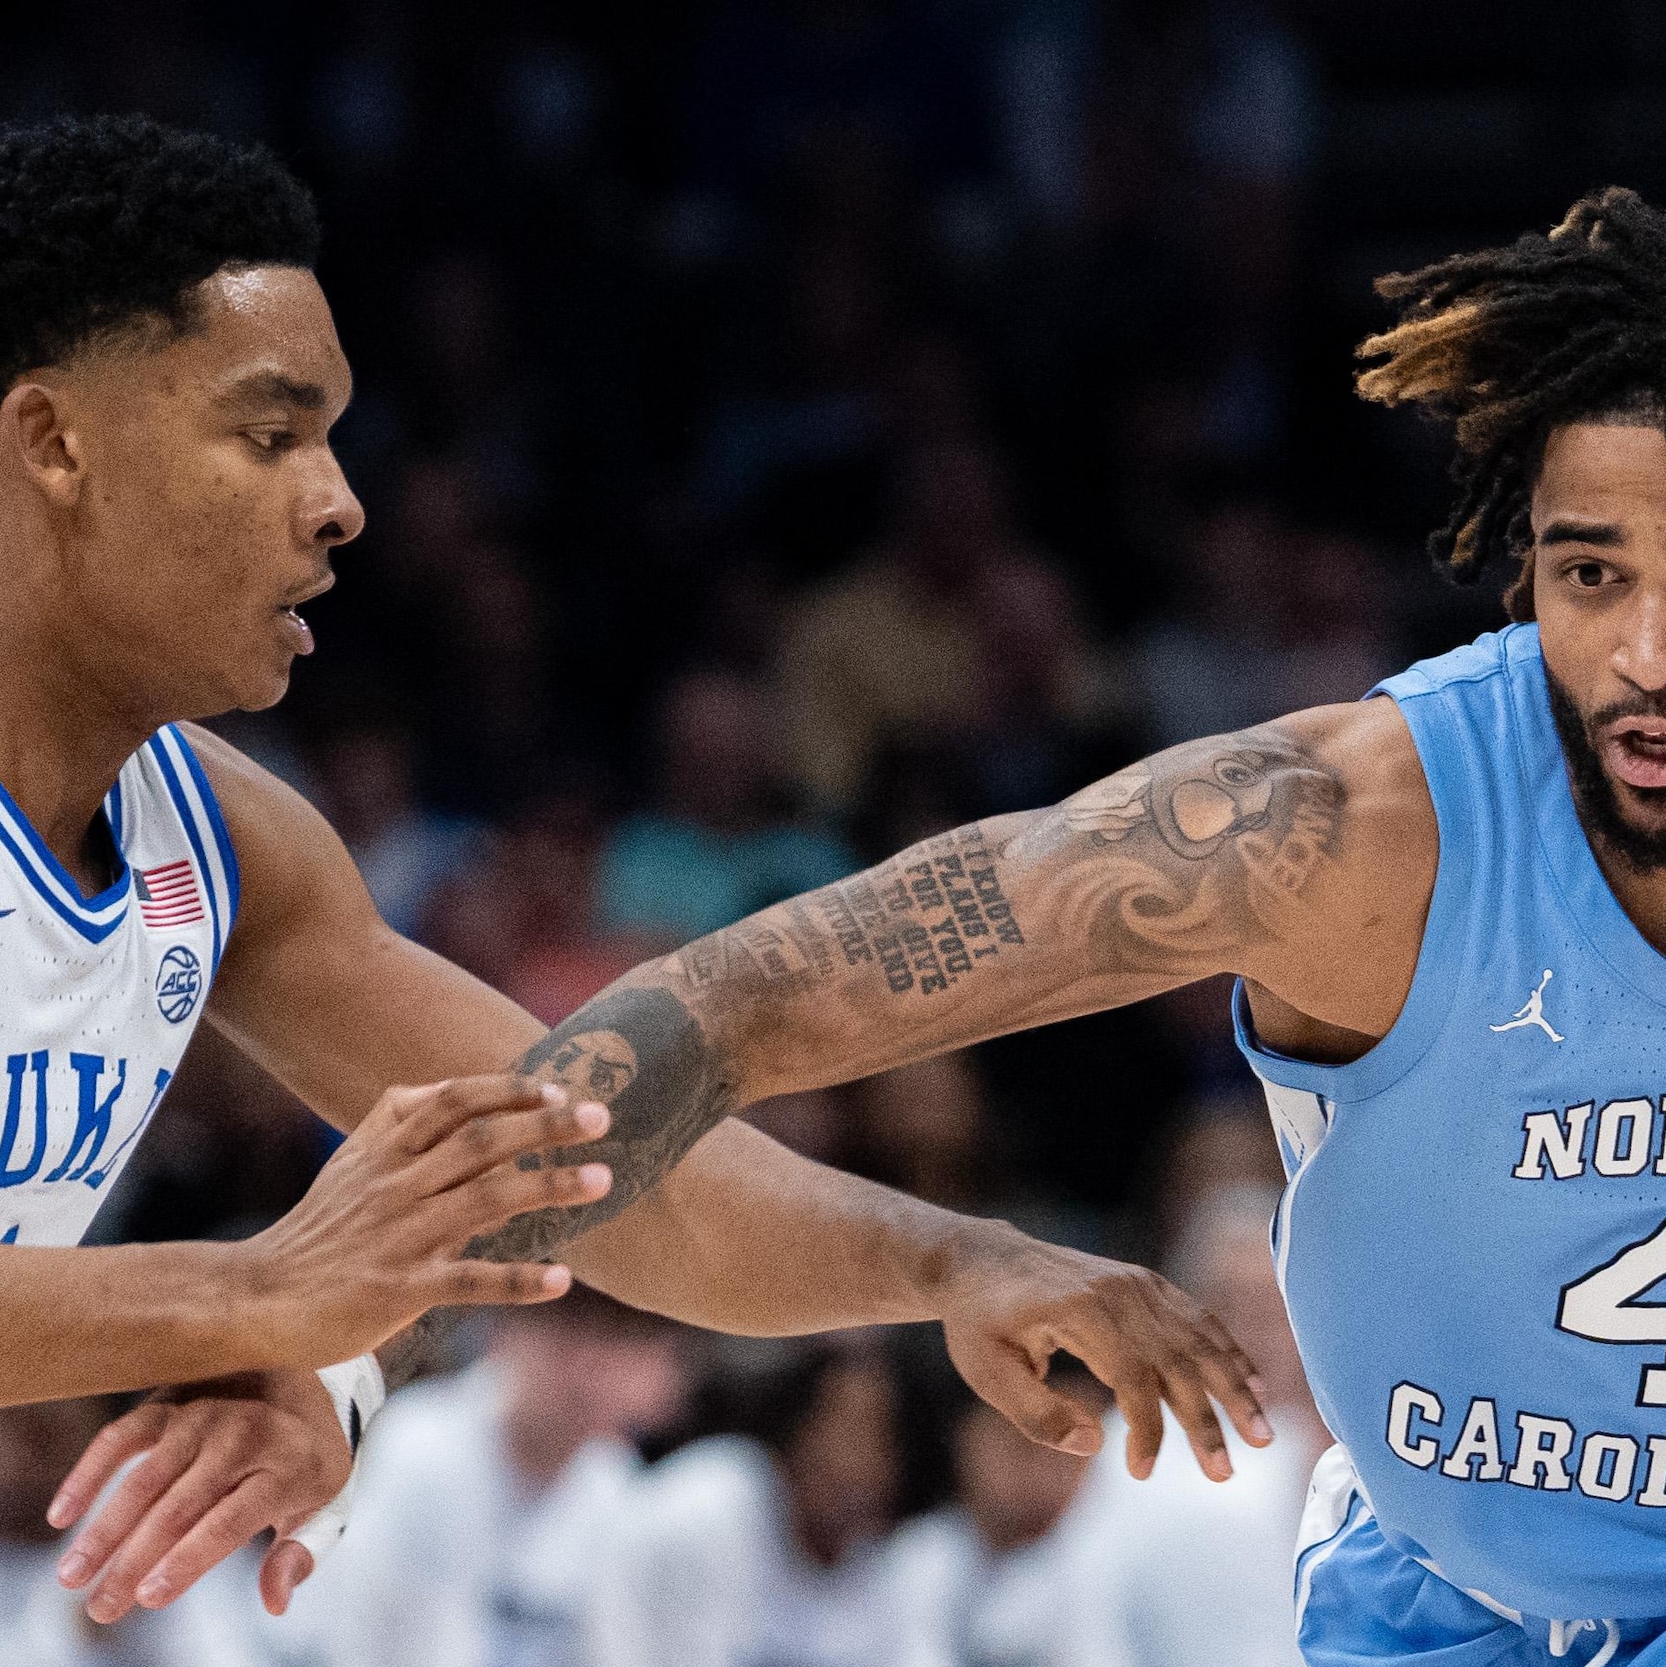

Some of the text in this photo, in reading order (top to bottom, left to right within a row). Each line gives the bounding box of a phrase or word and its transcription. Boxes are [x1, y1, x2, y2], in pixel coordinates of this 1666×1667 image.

[904, 860, 944, 912] FOR
[933, 853, 990, 938] PLANS
[973, 944, 999, 959] I
[969, 864, 1025, 945] KNOW
[873, 933, 915, 993] AND
